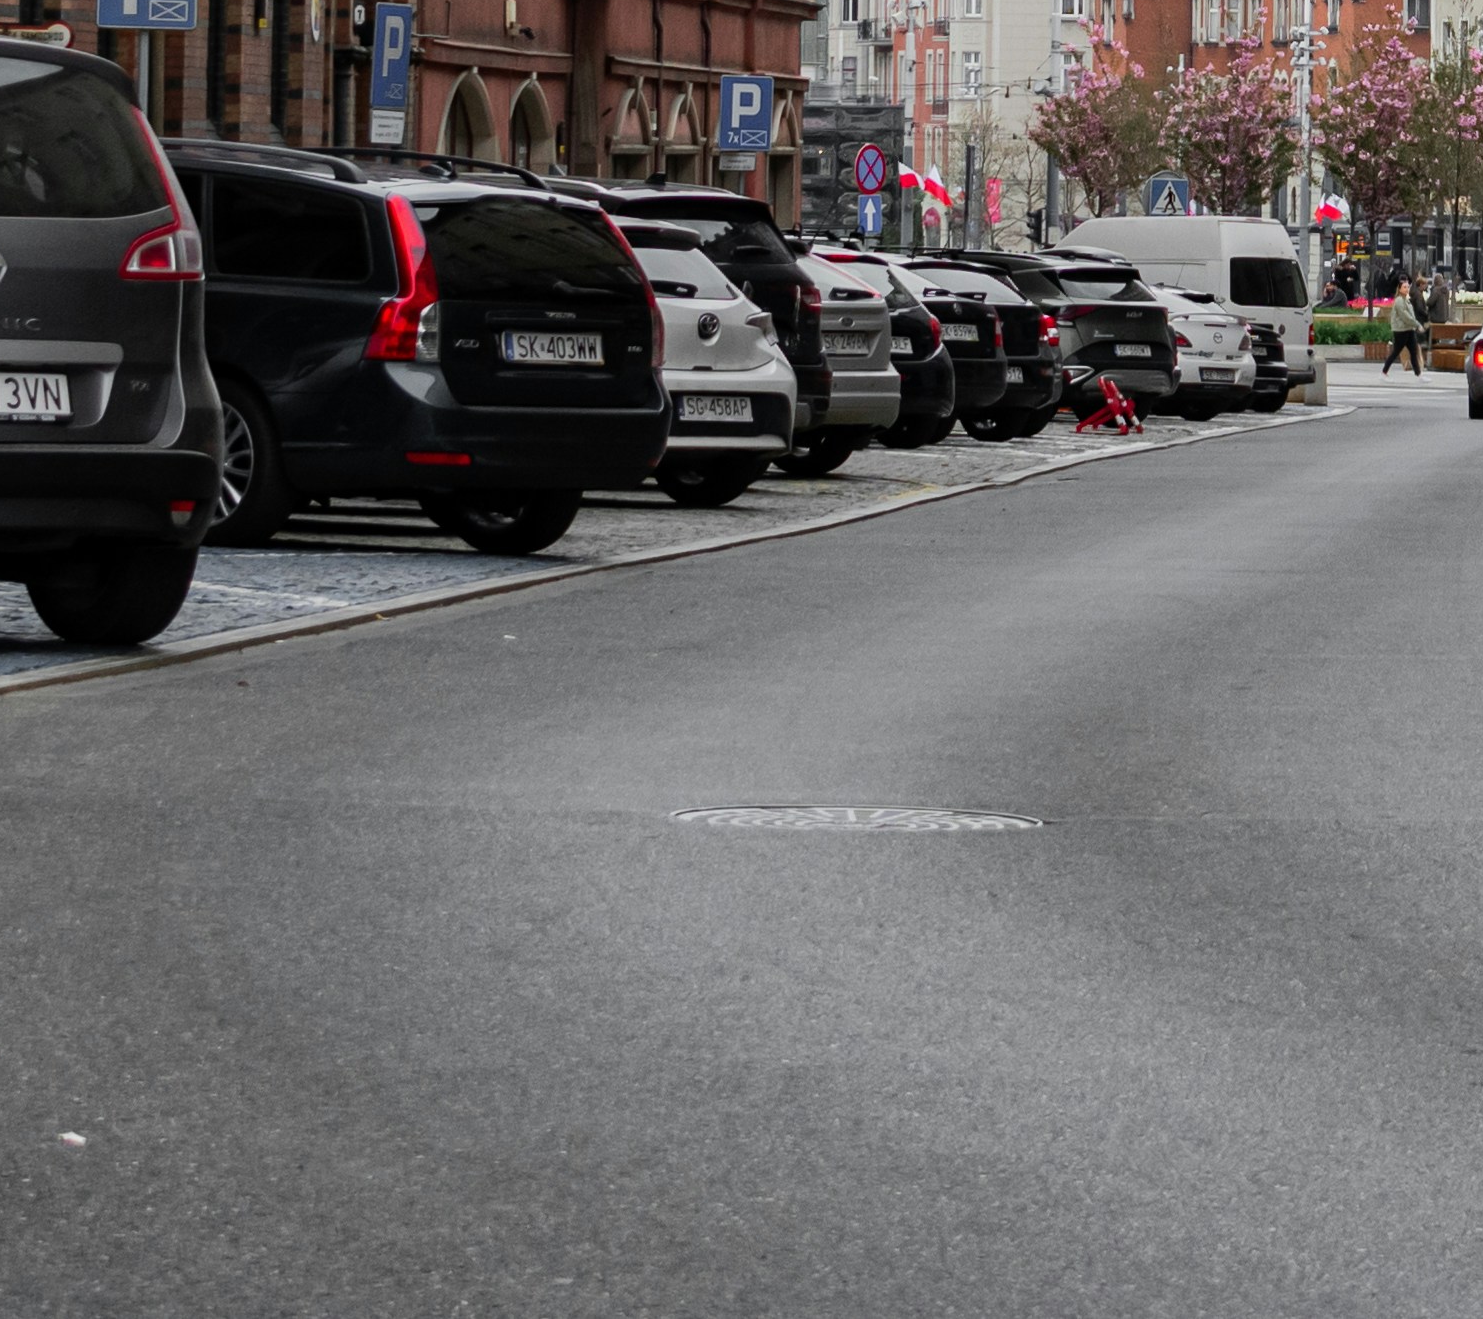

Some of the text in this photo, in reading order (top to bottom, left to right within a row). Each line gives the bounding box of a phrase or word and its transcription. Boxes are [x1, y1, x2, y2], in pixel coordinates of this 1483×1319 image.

[382, 15, 405, 77] P
[731, 82, 762, 128] P
[518, 334, 598, 360] SK 403WW
[686, 397, 748, 416] SG 458AP
